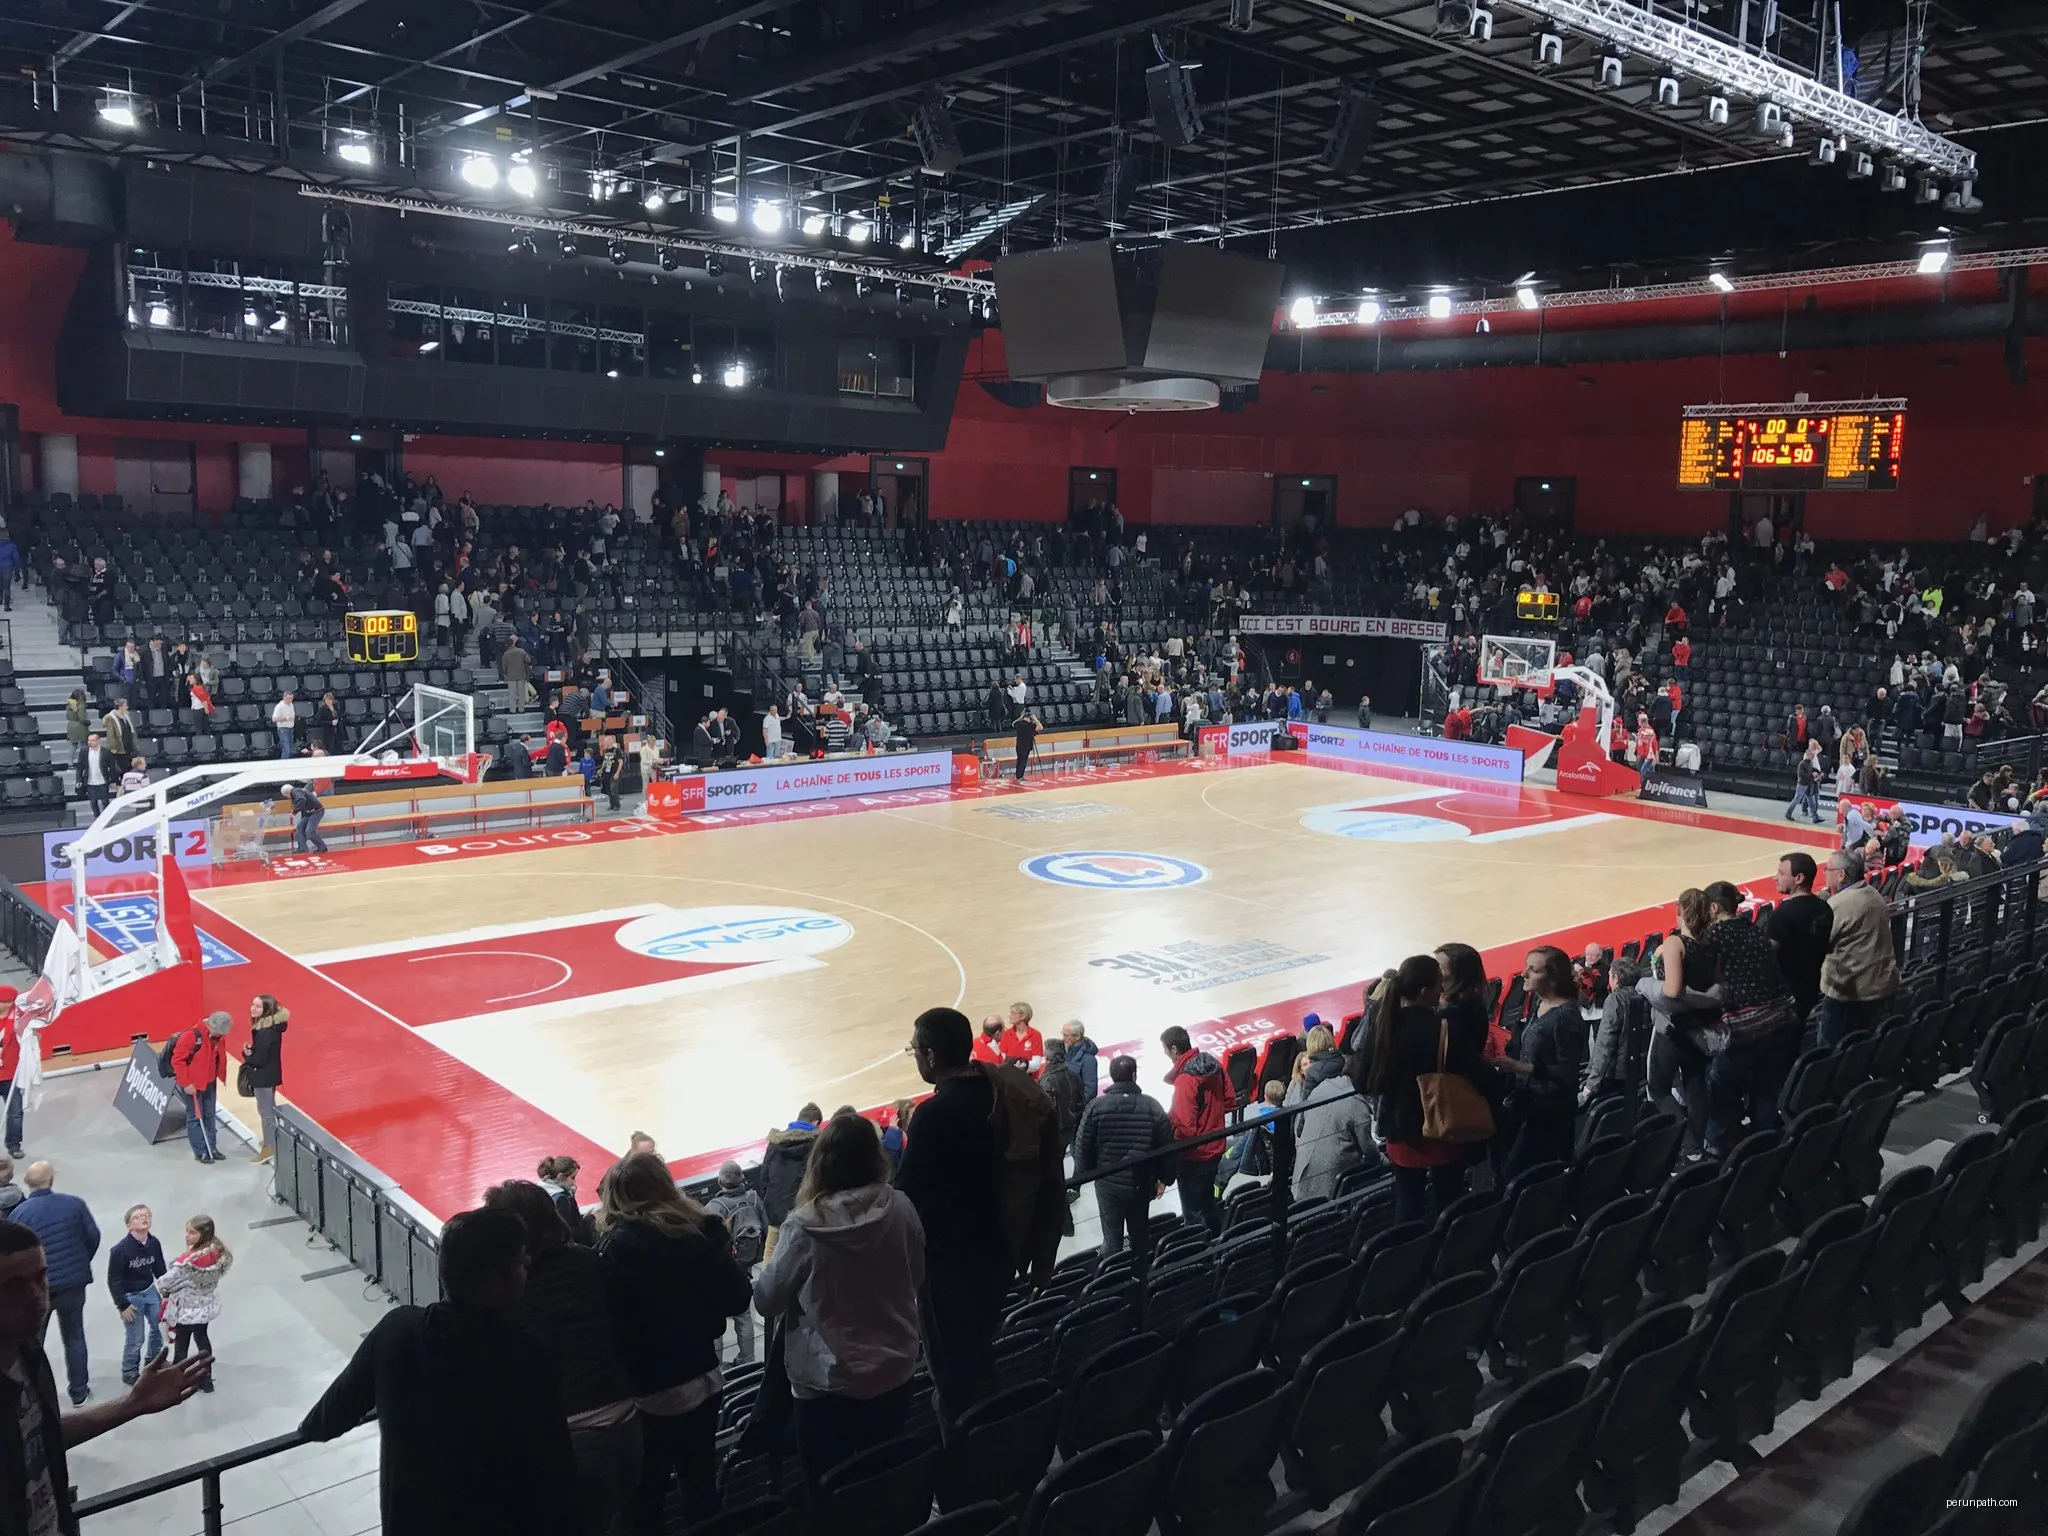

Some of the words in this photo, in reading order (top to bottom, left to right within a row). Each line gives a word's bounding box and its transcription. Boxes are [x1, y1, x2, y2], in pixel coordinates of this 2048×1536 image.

[1748, 422, 1757, 433] 4
[1766, 419, 1787, 434] 00
[1797, 418, 1808, 433] 0
[1818, 420, 1828, 433] 3
[1752, 448, 1775, 463] 106
[1793, 448, 1813, 463] 90
[1781, 444, 1790, 456] 4
[403, 615, 413, 631] 0
[1240, 618, 1260, 631] ICI
[1264, 618, 1303, 630] C'EST
[1309, 618, 1360, 633] BOURG
[1366, 620, 1385, 633] EN
[1391, 622, 1444, 637] BRESSE
[1203, 732, 1227, 749] SFR
[1292, 730, 1307, 742] SFR
[1309, 733, 1345, 747] SPORT2
[1358, 740, 1370, 750] LA
[1372, 741, 1405, 756] CHAÎNE
[1408, 748, 1421, 757] DE
[1424, 750, 1449, 761] TOUS
[1451, 753, 1469, 764] LES
[1471, 756, 1510, 770] SPORTS
[372, 768, 399, 777] MARTY
[777, 779, 790, 791] LA
[794, 774, 833, 789] CHAÎNE
[837, 773, 851, 783] DE
[854, 770, 881, 781] TOUS
[884, 767, 901, 779] LES
[904, 764, 941, 777] SPORTS
[1559, 769, 1596, 782] ArcelorMittal
[683, 785, 704, 800] SFR
[707, 782, 757, 798] SPORT2
[1645, 779, 1696, 799] bpifrance
[187, 790, 216, 807] MARTY
[1192, 1018, 1275, 1047] OURG
[125, 1058, 167, 1115] bpifrance
